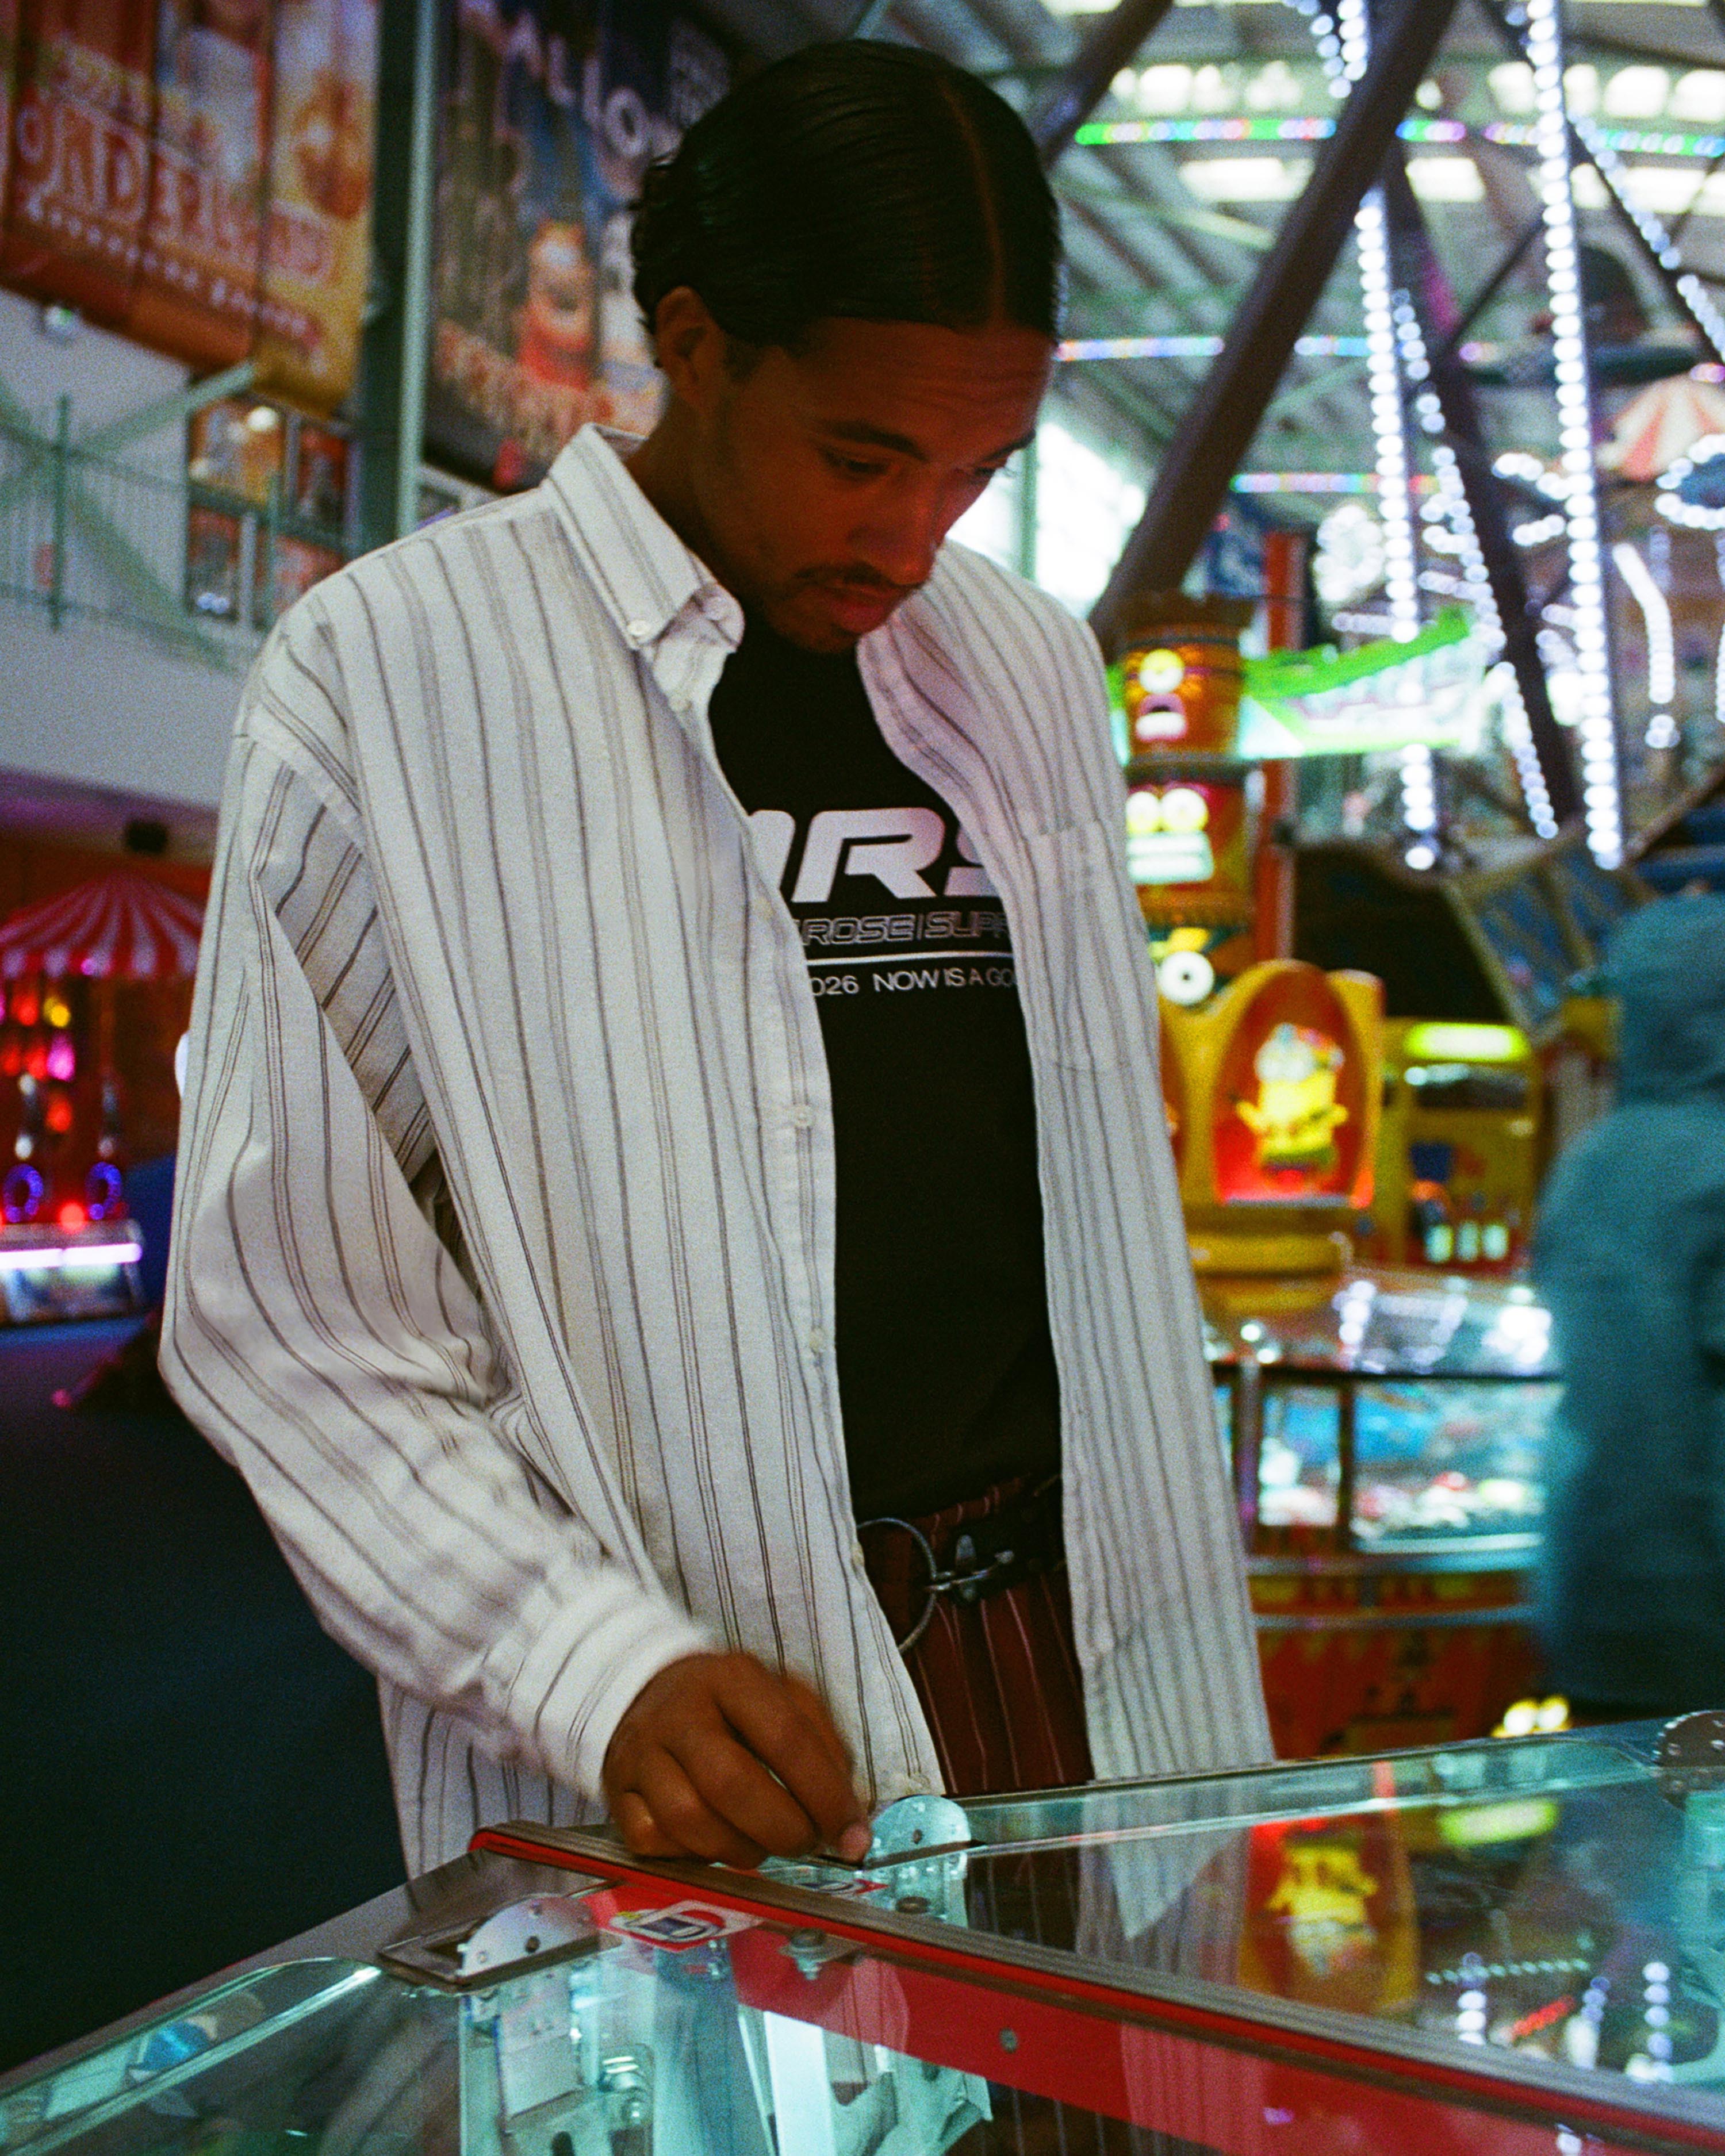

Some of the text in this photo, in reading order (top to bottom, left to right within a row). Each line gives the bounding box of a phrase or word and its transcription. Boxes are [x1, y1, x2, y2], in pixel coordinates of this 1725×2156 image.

[794, 914, 915, 946] ROSE
[873, 970, 940, 993] NOW
[944, 967, 966, 987] IS
[968, 968, 985, 985] A
